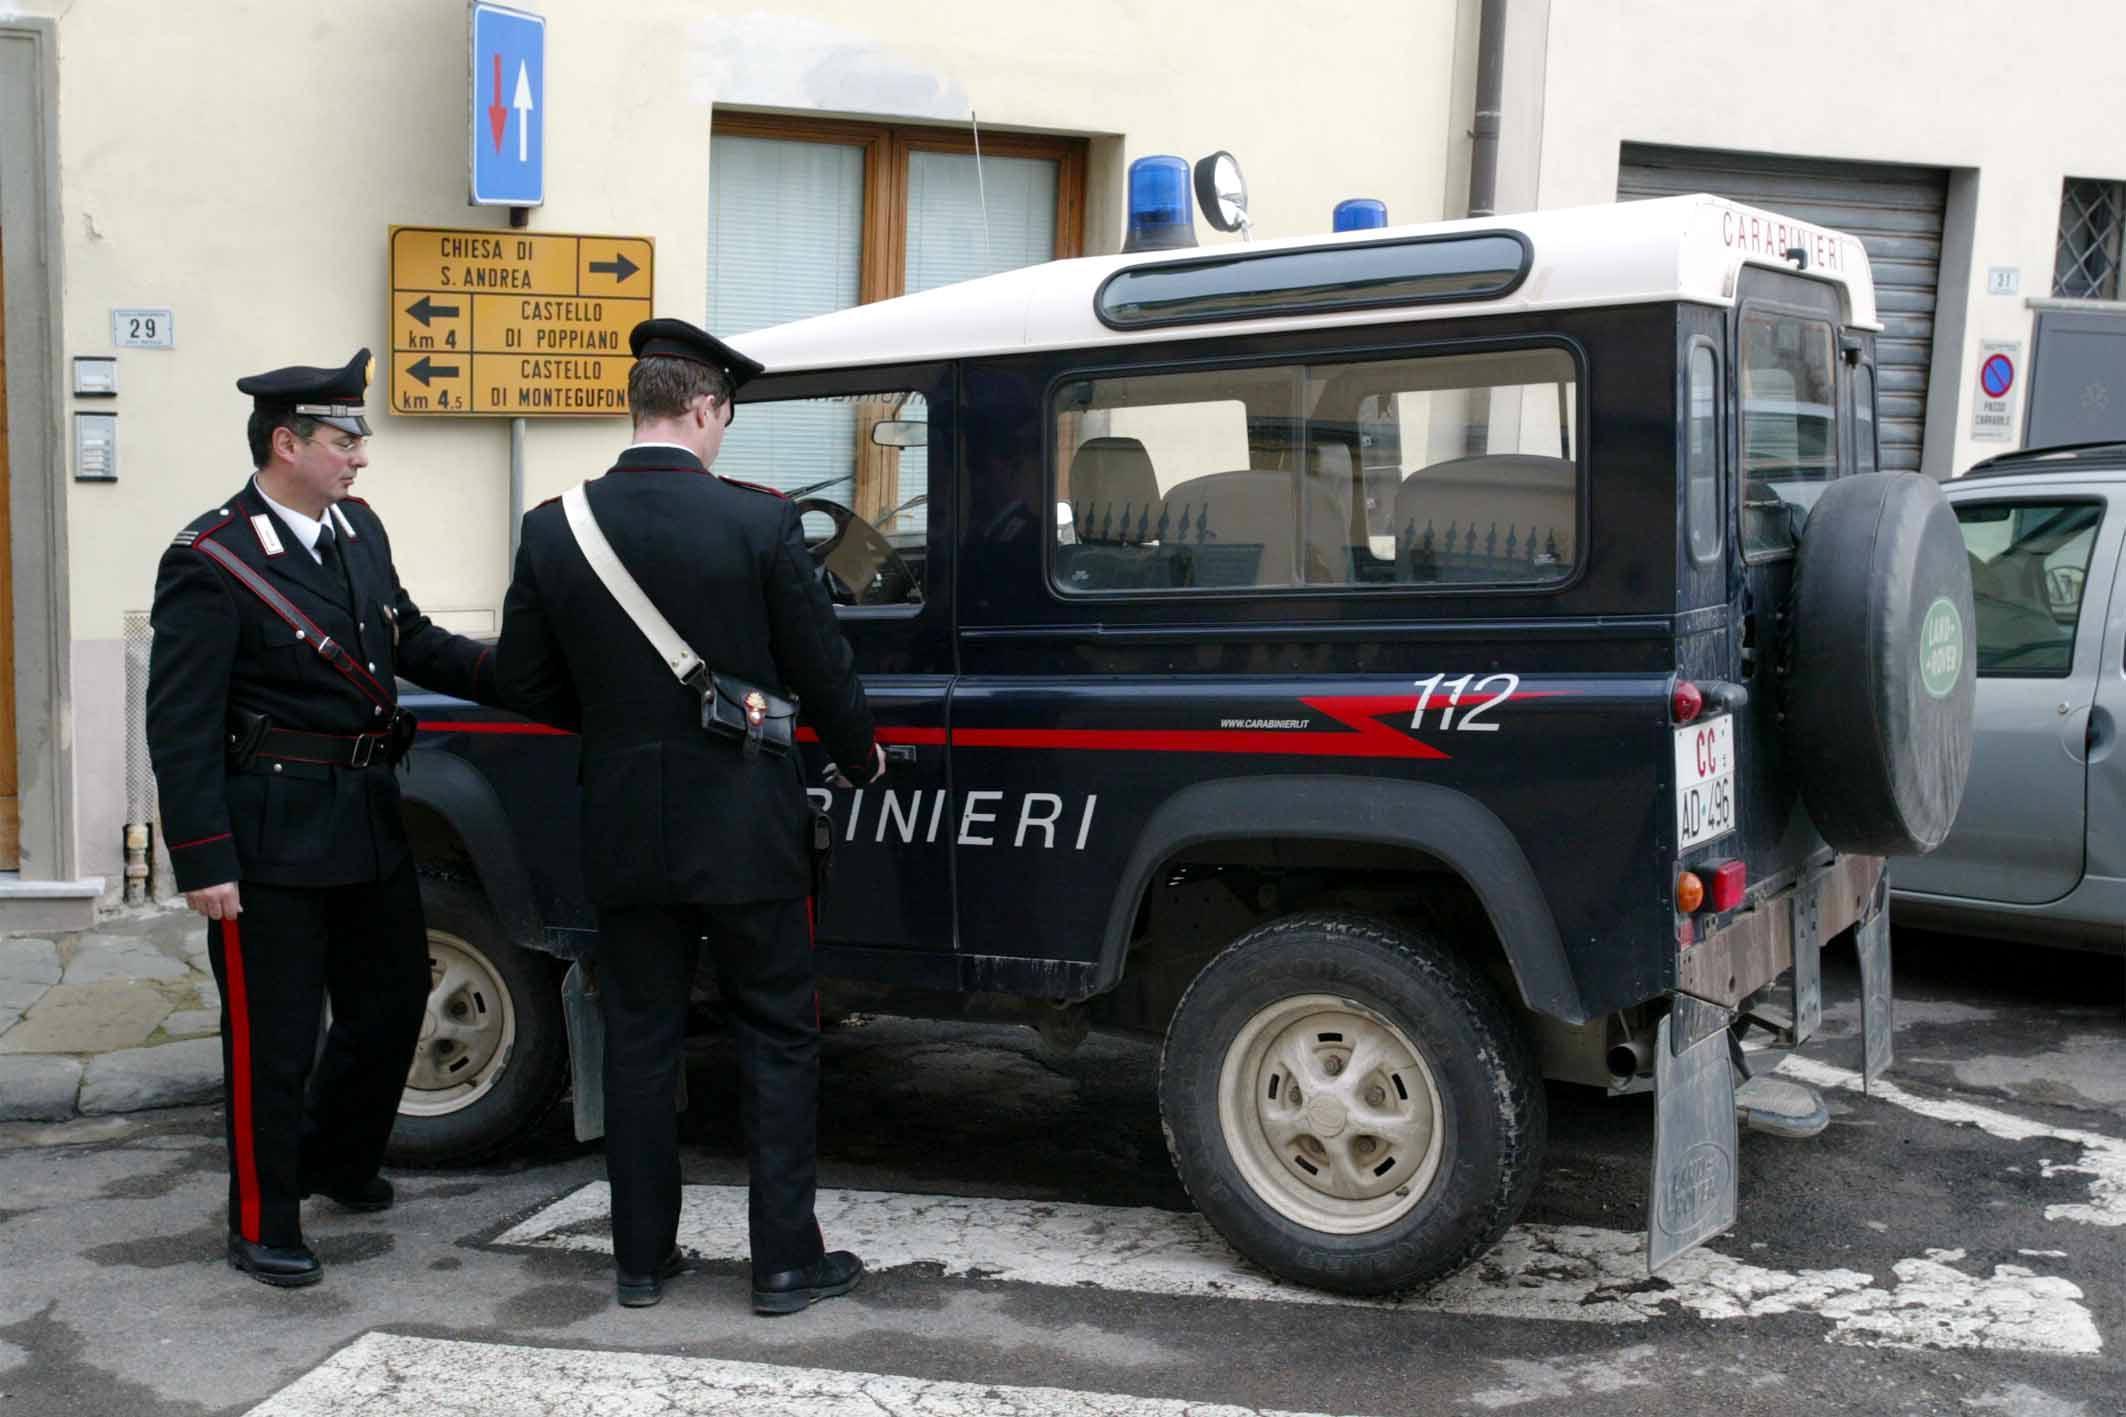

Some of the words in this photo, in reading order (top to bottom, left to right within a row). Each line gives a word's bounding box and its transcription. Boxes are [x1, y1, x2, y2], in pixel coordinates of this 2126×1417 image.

[440, 237, 503, 260] CHIESA
[516, 240, 533, 261] DI
[440, 266, 457, 287] S.
[463, 266, 532, 290] ANDREA
[521, 300, 603, 322] CASTELLO
[129, 318, 155, 338] 29
[408, 329, 434, 349] km
[444, 329, 457, 349] 4
[505, 327, 522, 348] DI
[536, 328, 619, 350] POPPIANO
[521, 359, 602, 380] CASTELLO
[403, 391, 428, 409] km
[490, 387, 507, 407] DI
[518, 386, 626, 408] MONTEGUFON
[1411, 673, 1520, 731] 112
[1695, 727, 1716, 778] CC
[1681, 788, 1701, 840] AD
[1707, 777, 1730, 830] 496
